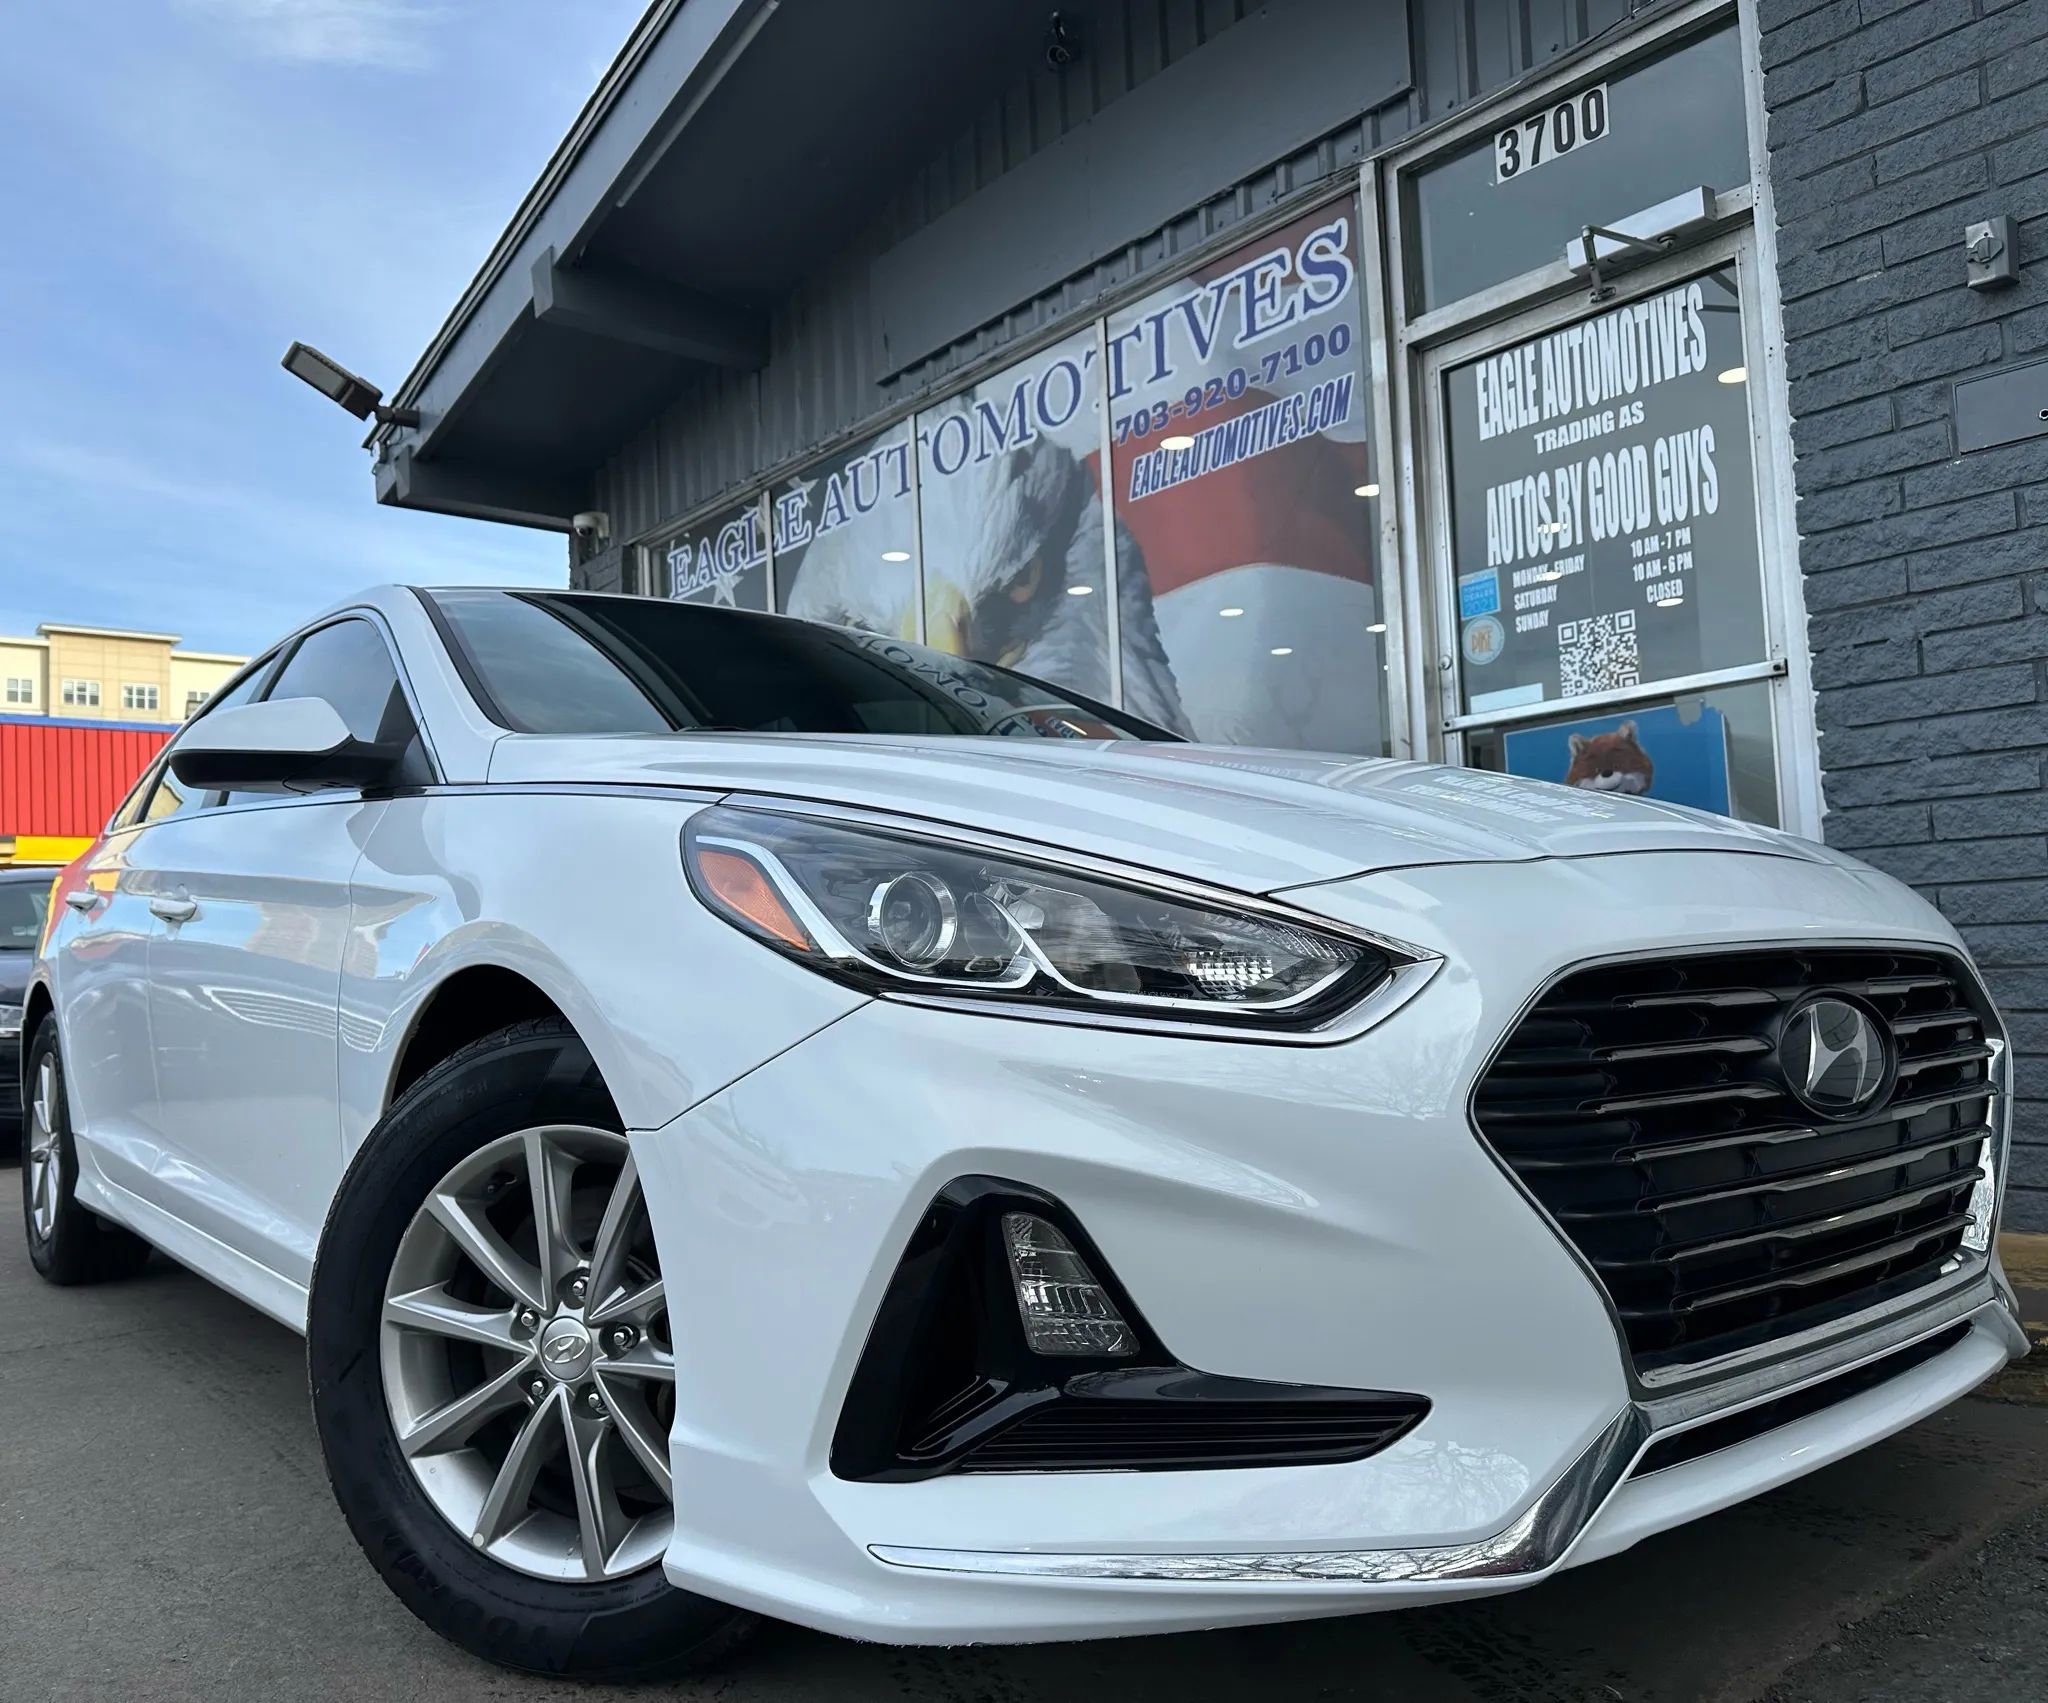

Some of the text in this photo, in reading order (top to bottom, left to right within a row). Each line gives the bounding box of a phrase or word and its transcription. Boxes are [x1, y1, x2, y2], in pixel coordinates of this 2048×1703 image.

[1499, 88, 1605, 178] 3700
[1115, 323, 1351, 447] 703-920-7100
[1475, 282, 1708, 442] EAGLE AUTOMOTIVES
[668, 217, 1353, 599] EAGLE AUTOMOTIVES
[1534, 400, 1645, 455] TRADING AS
[1129, 373, 1354, 502] EAGLEAUTOMOTIVES.COM
[1486, 424, 1719, 567] AUTOS BY GOOD GUYS
[1630, 539, 1643, 558] 10
[1644, 534, 1660, 556] AM
[1665, 531, 1672, 549] 7
[1675, 526, 1691, 547] PM
[1632, 563, 1645, 582] 10
[1646, 558, 1661, 579] AM
[1668, 555, 1676, 573] 6
[1676, 551, 1693, 572] PM
[1512, 563, 1548, 588] MONDAY
[1554, 554, 1585, 576] FRIDAY
[1514, 584, 1558, 611] SATURDAY
[1646, 578, 1683, 603] CLOSED
[1515, 609, 1549, 633] SUNDAY
